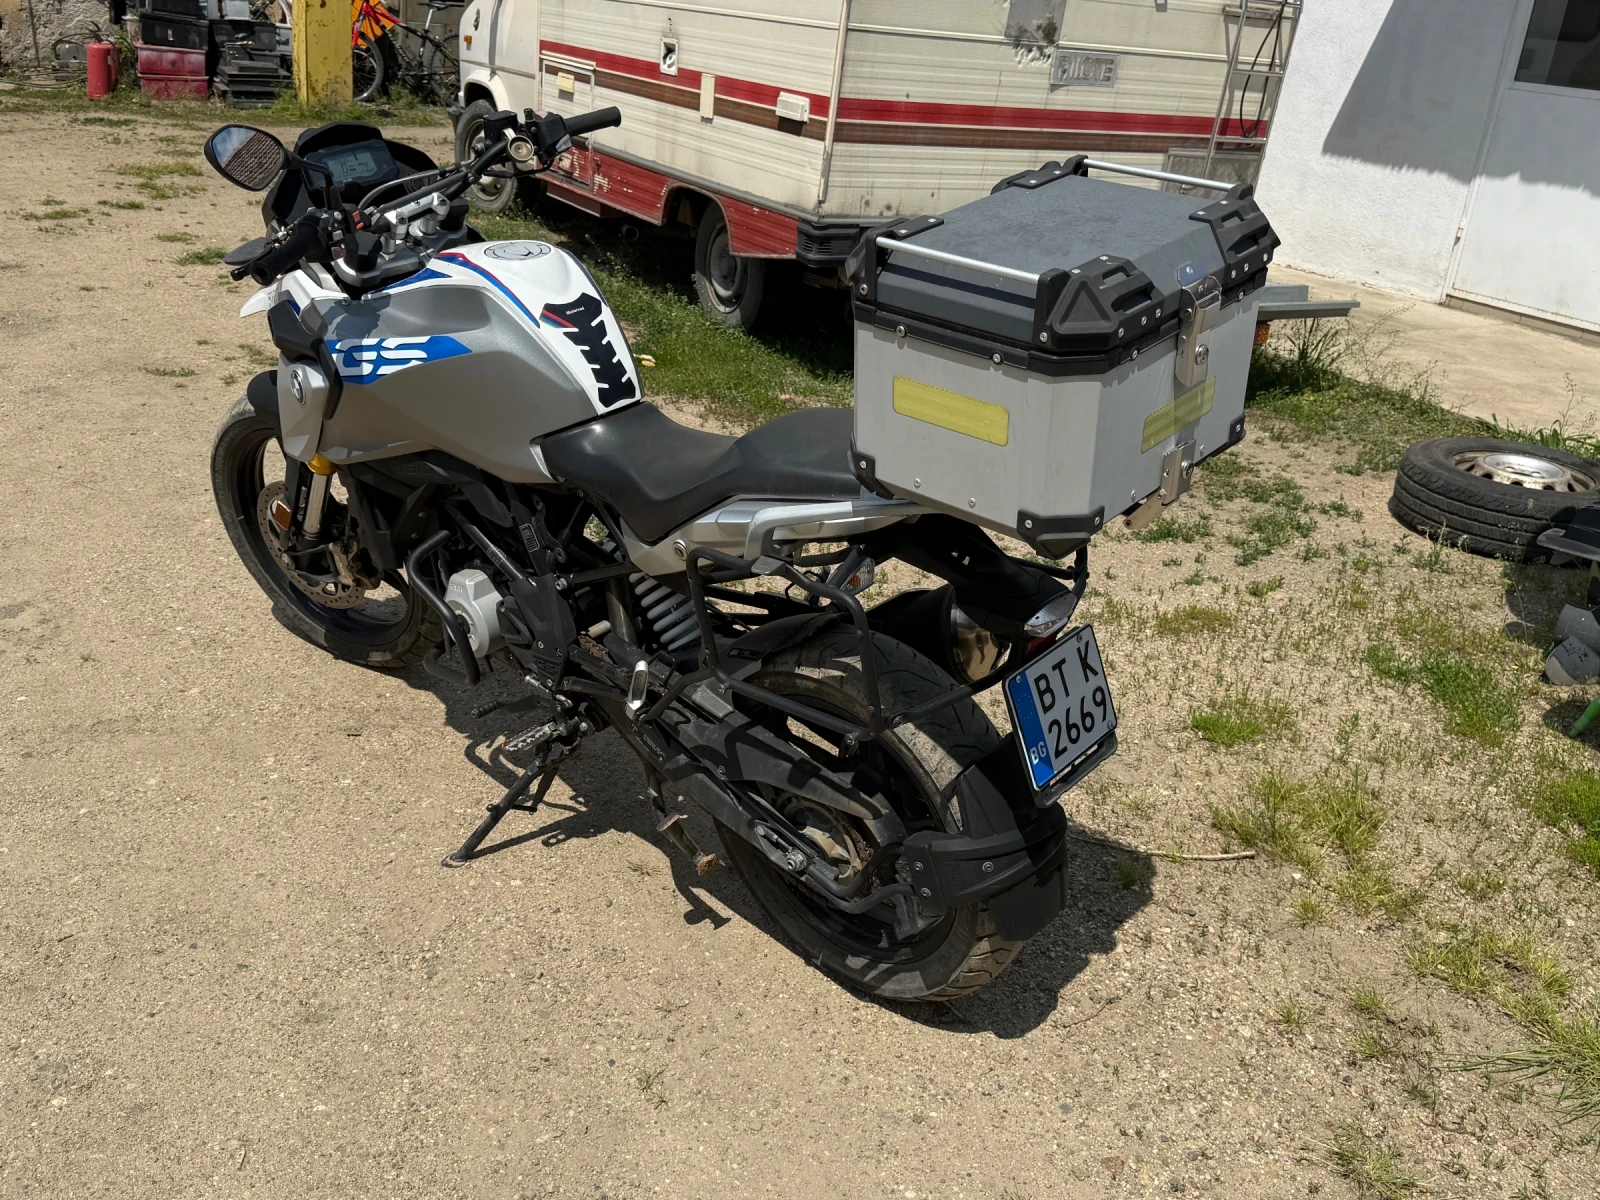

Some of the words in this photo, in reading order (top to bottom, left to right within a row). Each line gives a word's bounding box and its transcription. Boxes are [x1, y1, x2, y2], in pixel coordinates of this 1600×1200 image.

[1057, 55, 1115, 82] PILOTE
[332, 336, 428, 377] GS
[1048, 686, 1107, 760] 2669
[1030, 741, 1047, 765] BG
